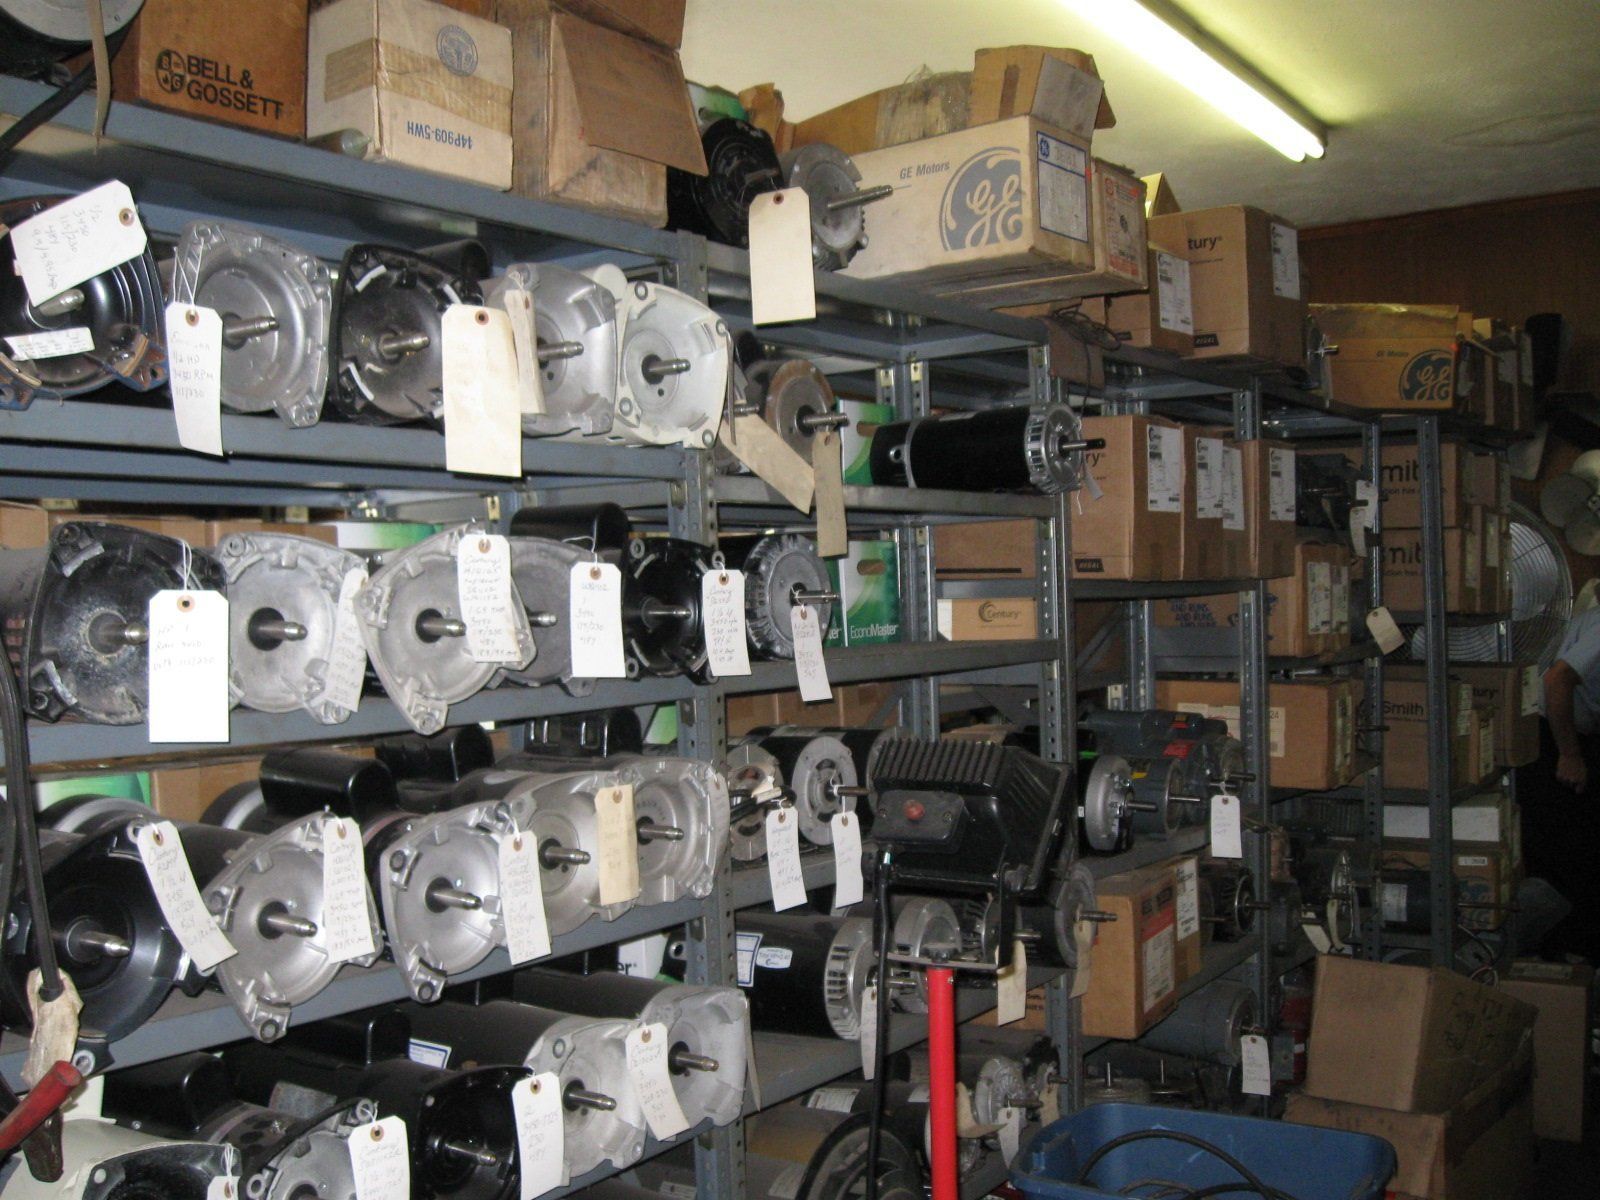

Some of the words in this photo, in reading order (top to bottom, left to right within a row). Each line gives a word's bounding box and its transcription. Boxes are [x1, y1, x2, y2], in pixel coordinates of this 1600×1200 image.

[186, 54, 237, 86] BELL
[239, 68, 255, 91] &
[186, 79, 285, 121] GOSSETT
[899, 165, 913, 180] GE
[915, 160, 951, 178] Motors
[1187, 236, 1215, 252] tury
